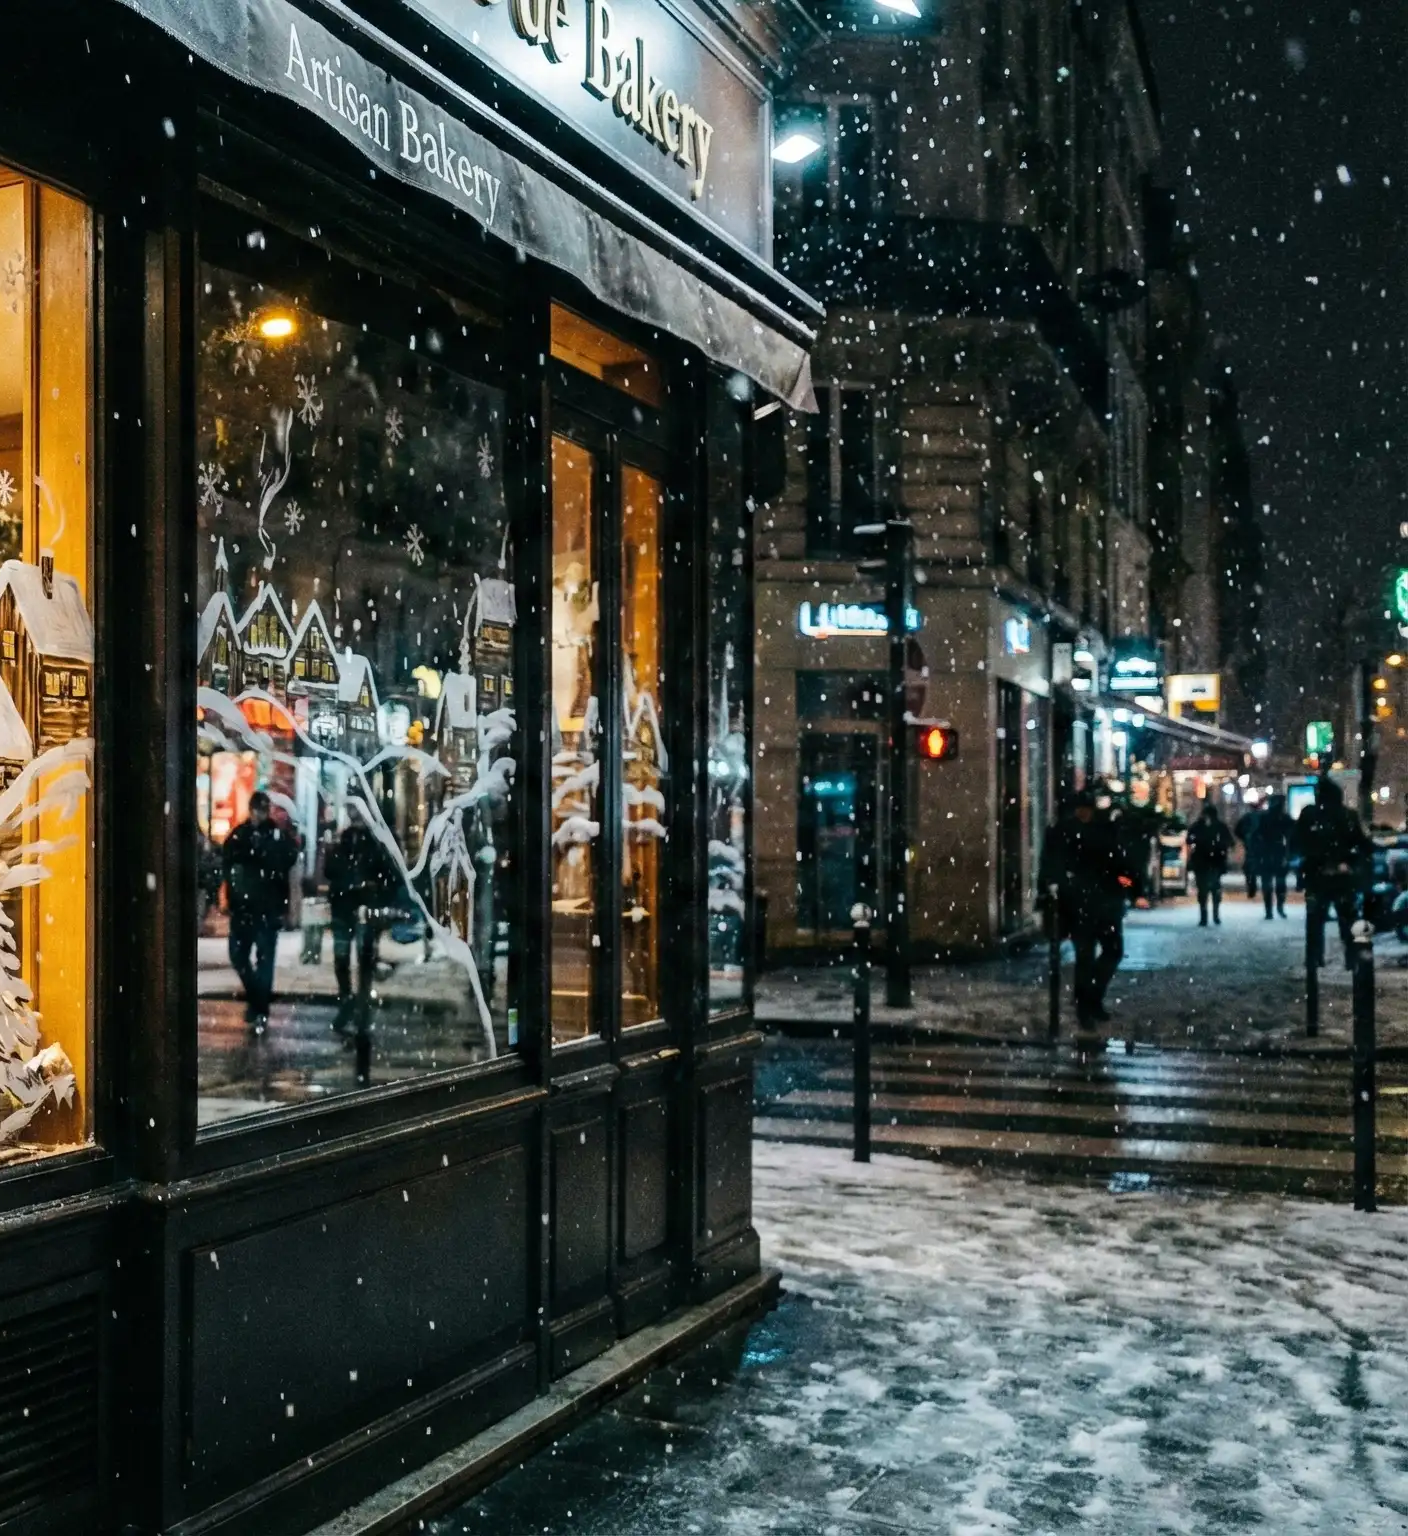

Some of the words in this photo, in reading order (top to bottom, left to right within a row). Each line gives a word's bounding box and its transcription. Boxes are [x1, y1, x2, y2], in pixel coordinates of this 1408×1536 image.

[284, 22, 391, 152] Artisan
[398, 99, 501, 226] Bakery
[582, 0, 714, 200] Bakery
